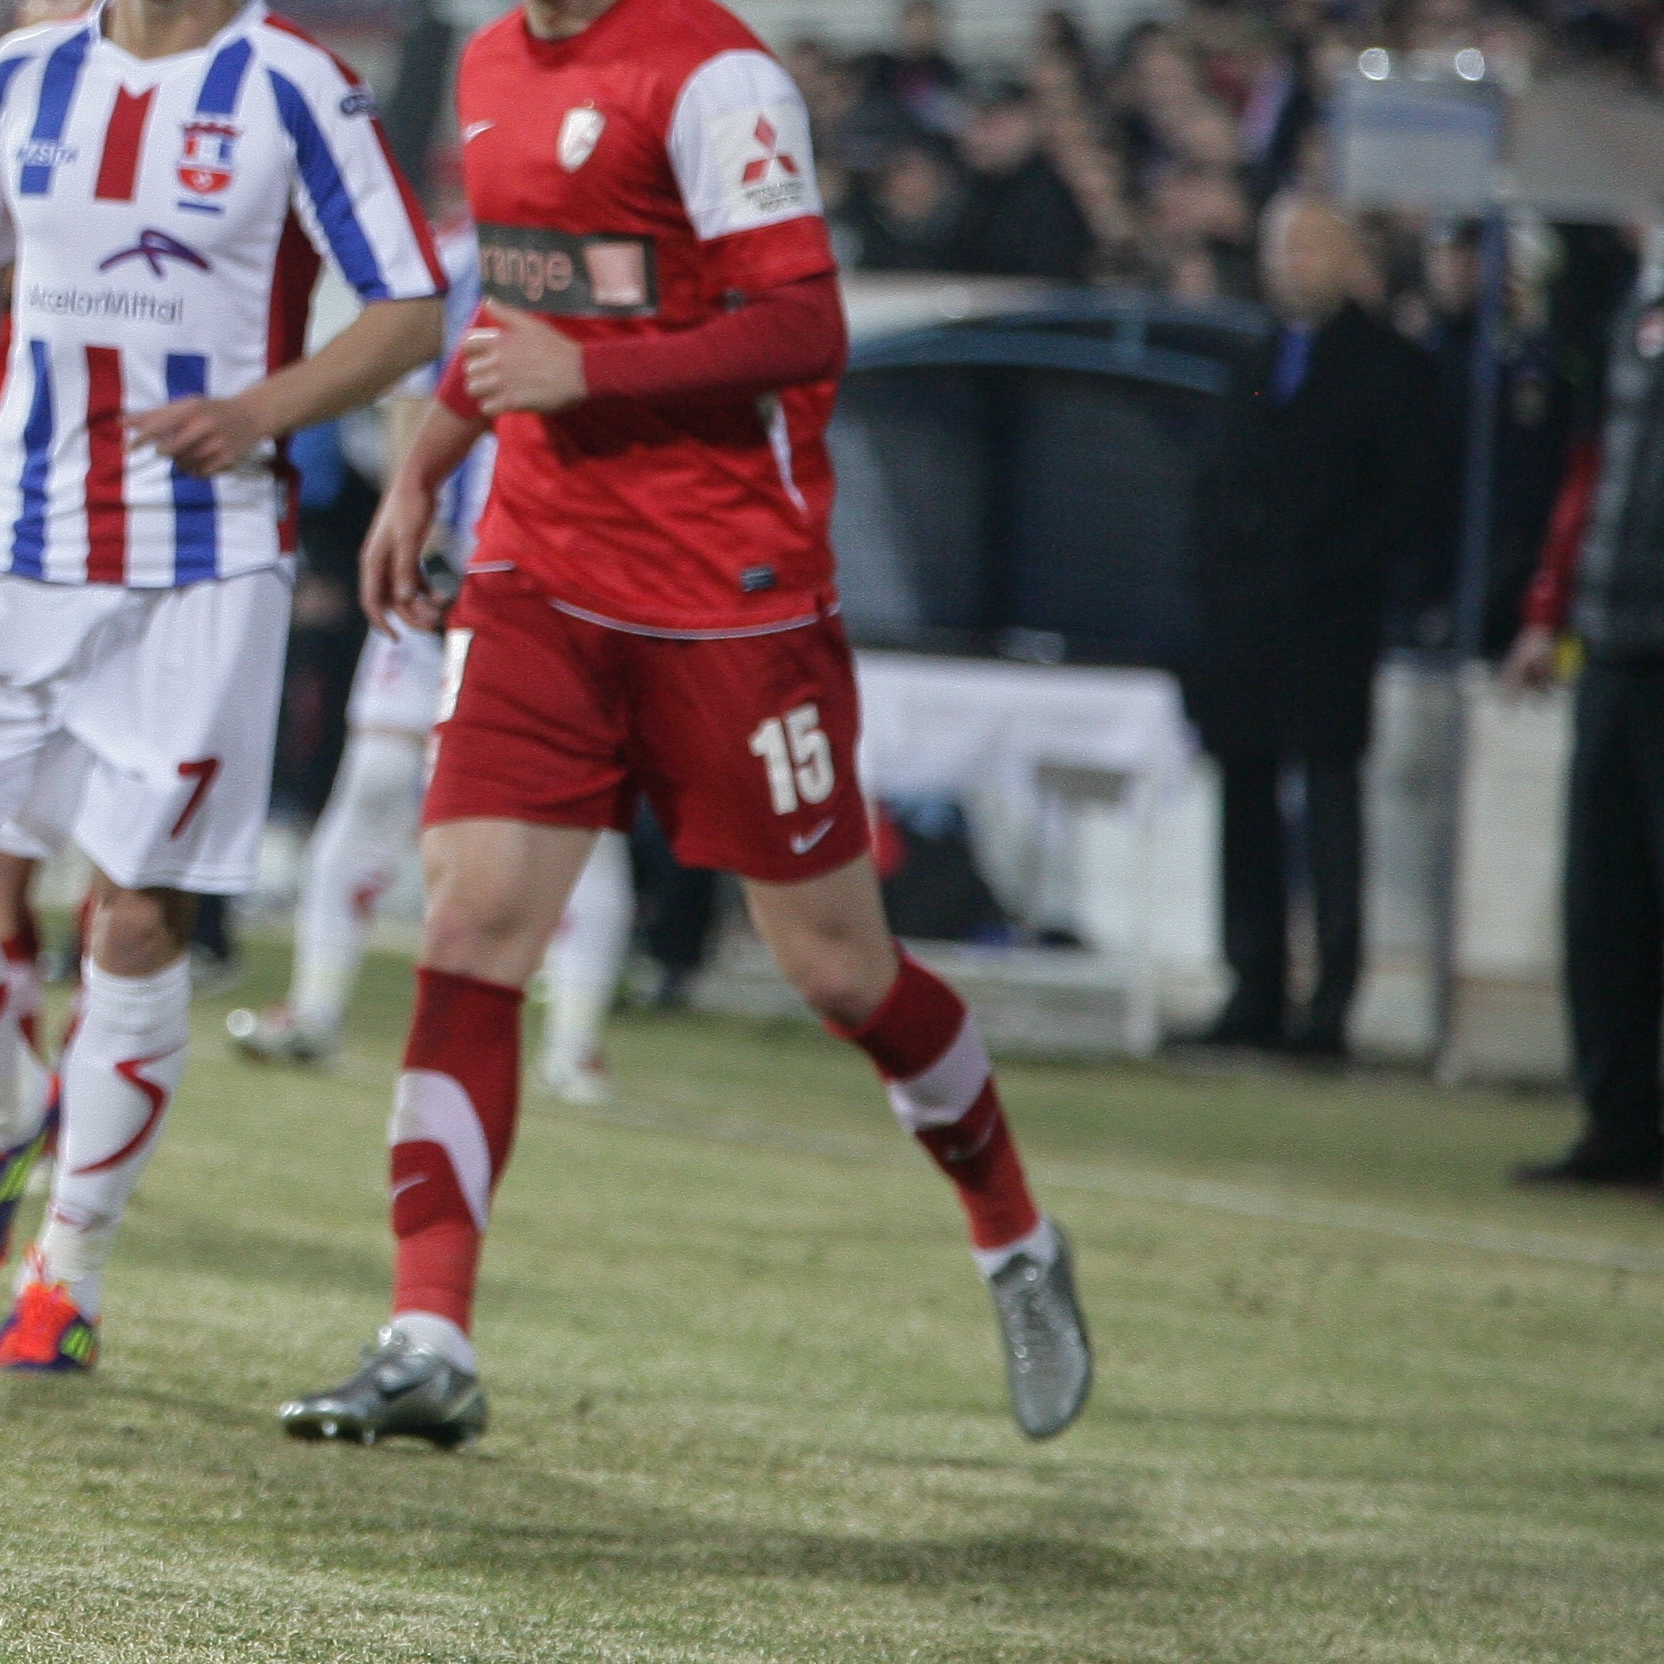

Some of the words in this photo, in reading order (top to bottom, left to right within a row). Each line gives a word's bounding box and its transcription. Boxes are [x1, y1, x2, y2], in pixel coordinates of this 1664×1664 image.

[480, 244, 573, 303] range
[170, 757, 219, 840] 7
[747, 701, 836, 816] 15
